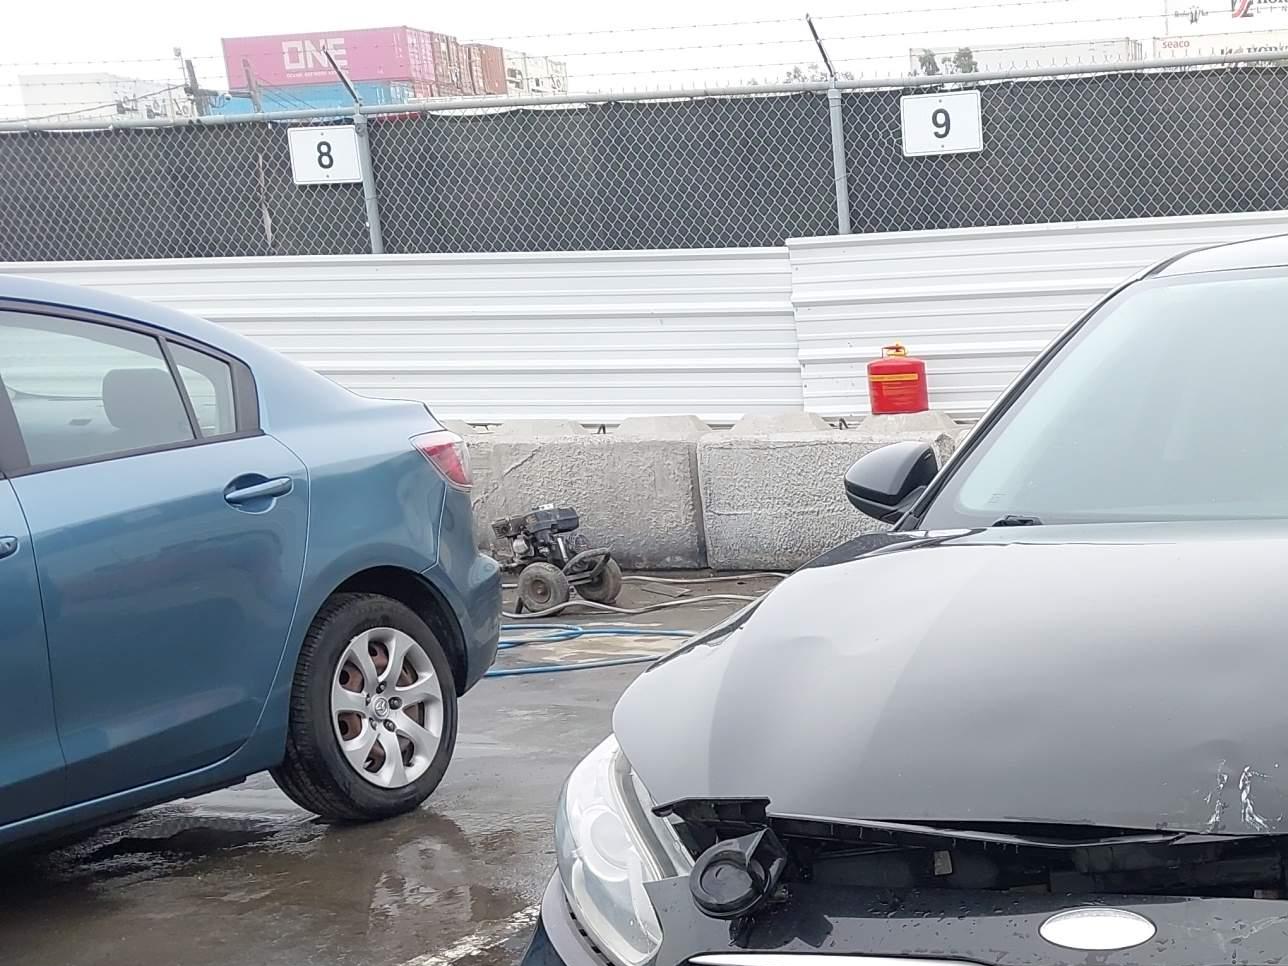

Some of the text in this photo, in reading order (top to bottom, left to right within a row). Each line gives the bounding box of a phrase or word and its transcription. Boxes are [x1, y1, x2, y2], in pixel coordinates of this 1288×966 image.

[282, 38, 348, 70] ONE
[1162, 40, 1190, 49] seaco
[932, 108, 951, 139] 9
[317, 141, 334, 169] 8
